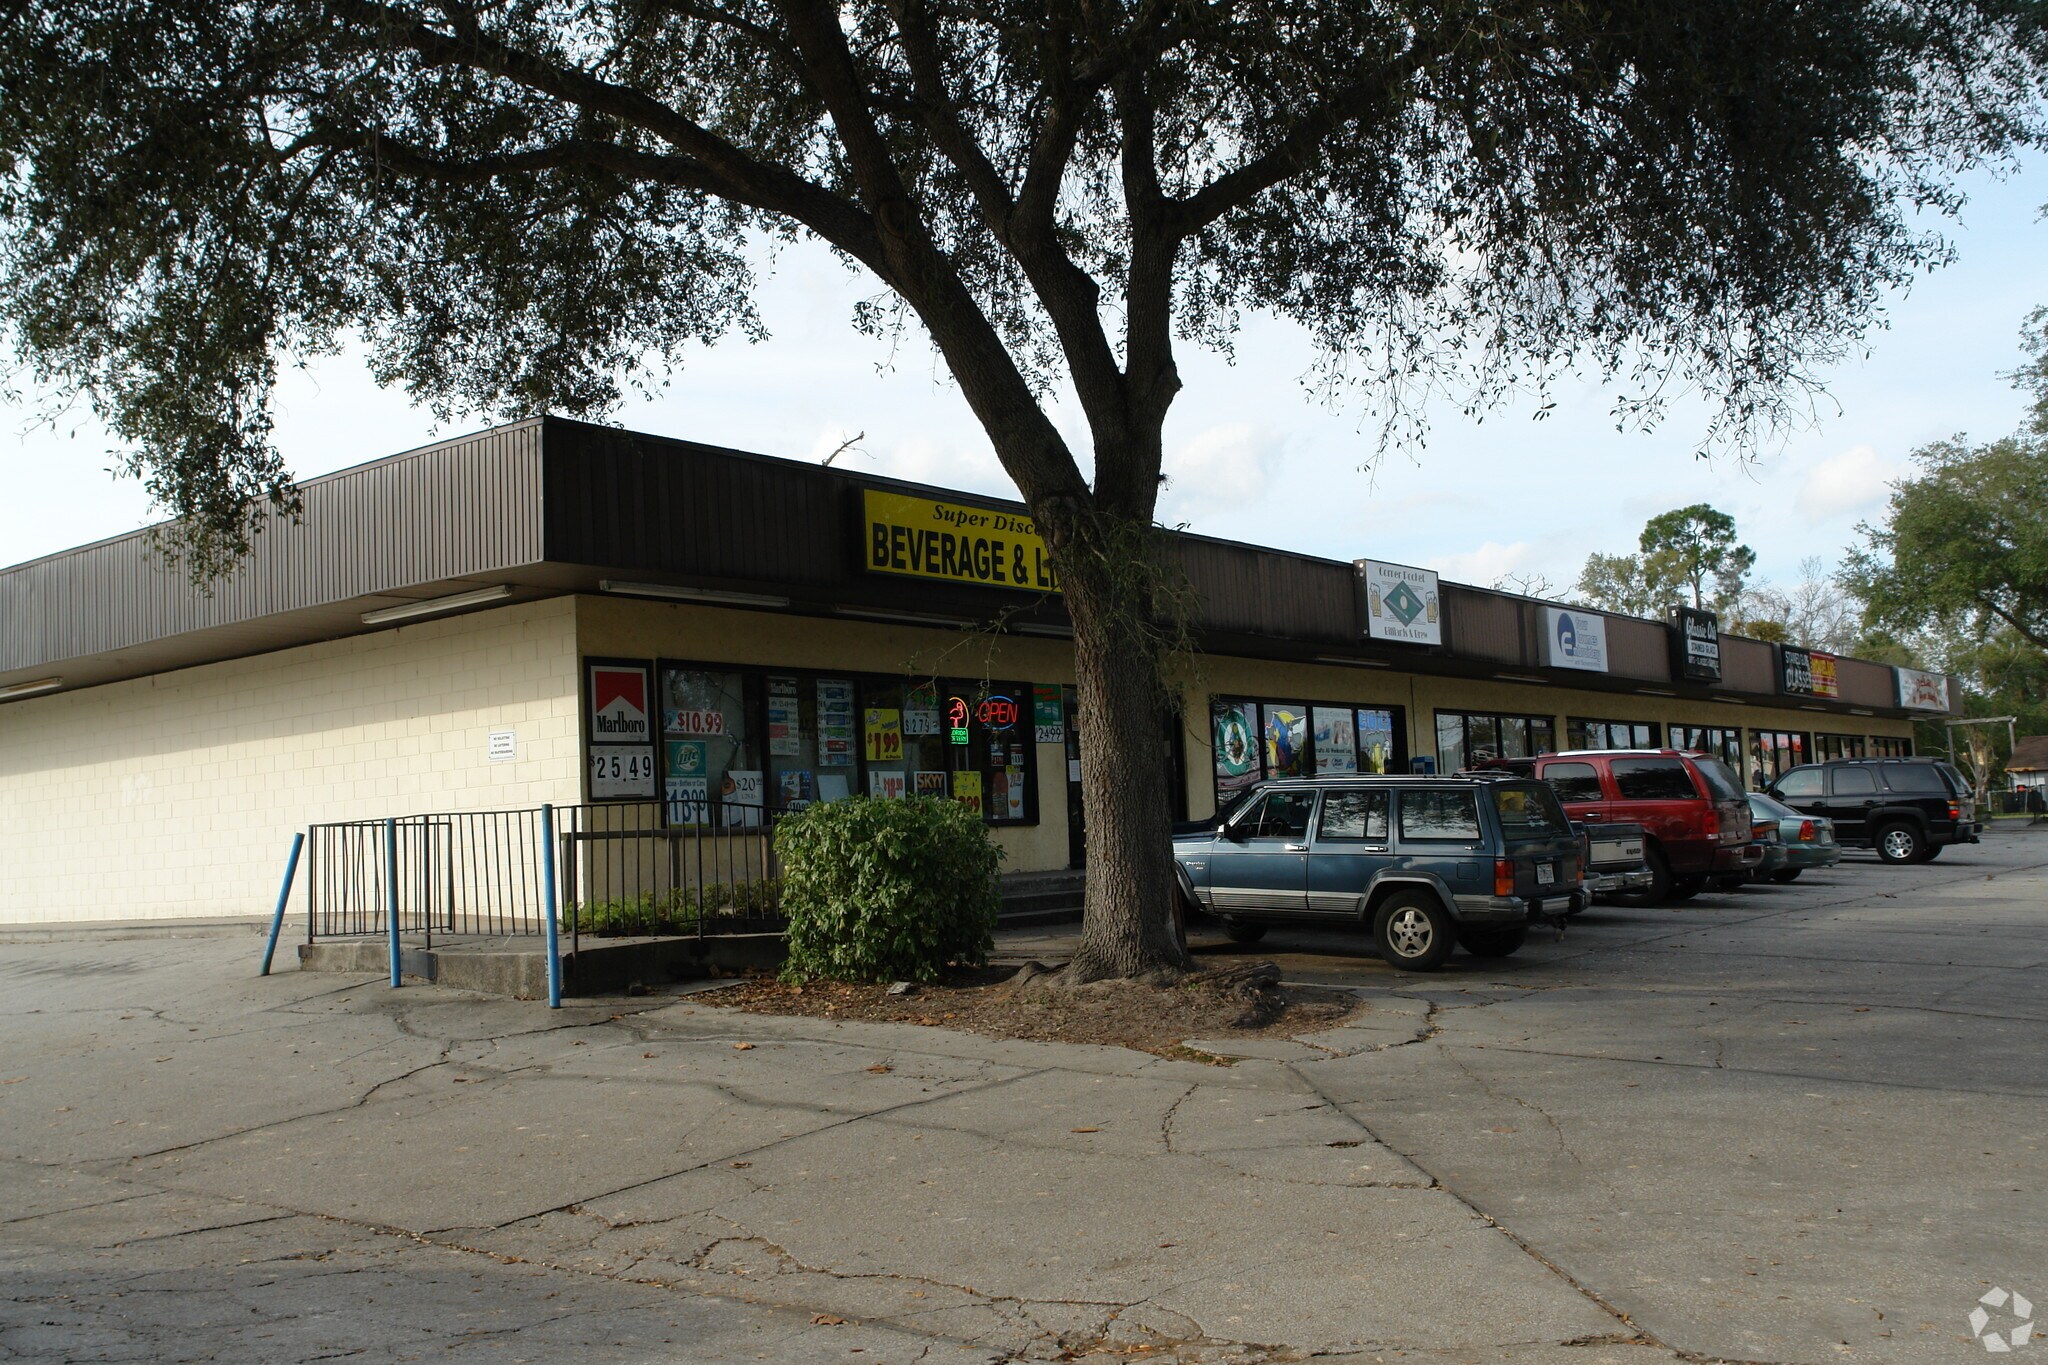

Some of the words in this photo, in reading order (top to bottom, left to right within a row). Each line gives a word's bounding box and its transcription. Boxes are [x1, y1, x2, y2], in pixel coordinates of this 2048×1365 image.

[933, 504, 989, 527] Super
[873, 523, 1005, 582] BEVERAGE
[1012, 544, 1029, 584] &
[1378, 566, 1401, 579] Corner
[1403, 571, 1425, 583] Pocket
[597, 711, 645, 734] Marlboro
[677, 711, 722, 733] $10.99
[978, 702, 1018, 723] OPEN
[678, 751, 697, 765] Lite
[917, 774, 944, 788] SKYY
